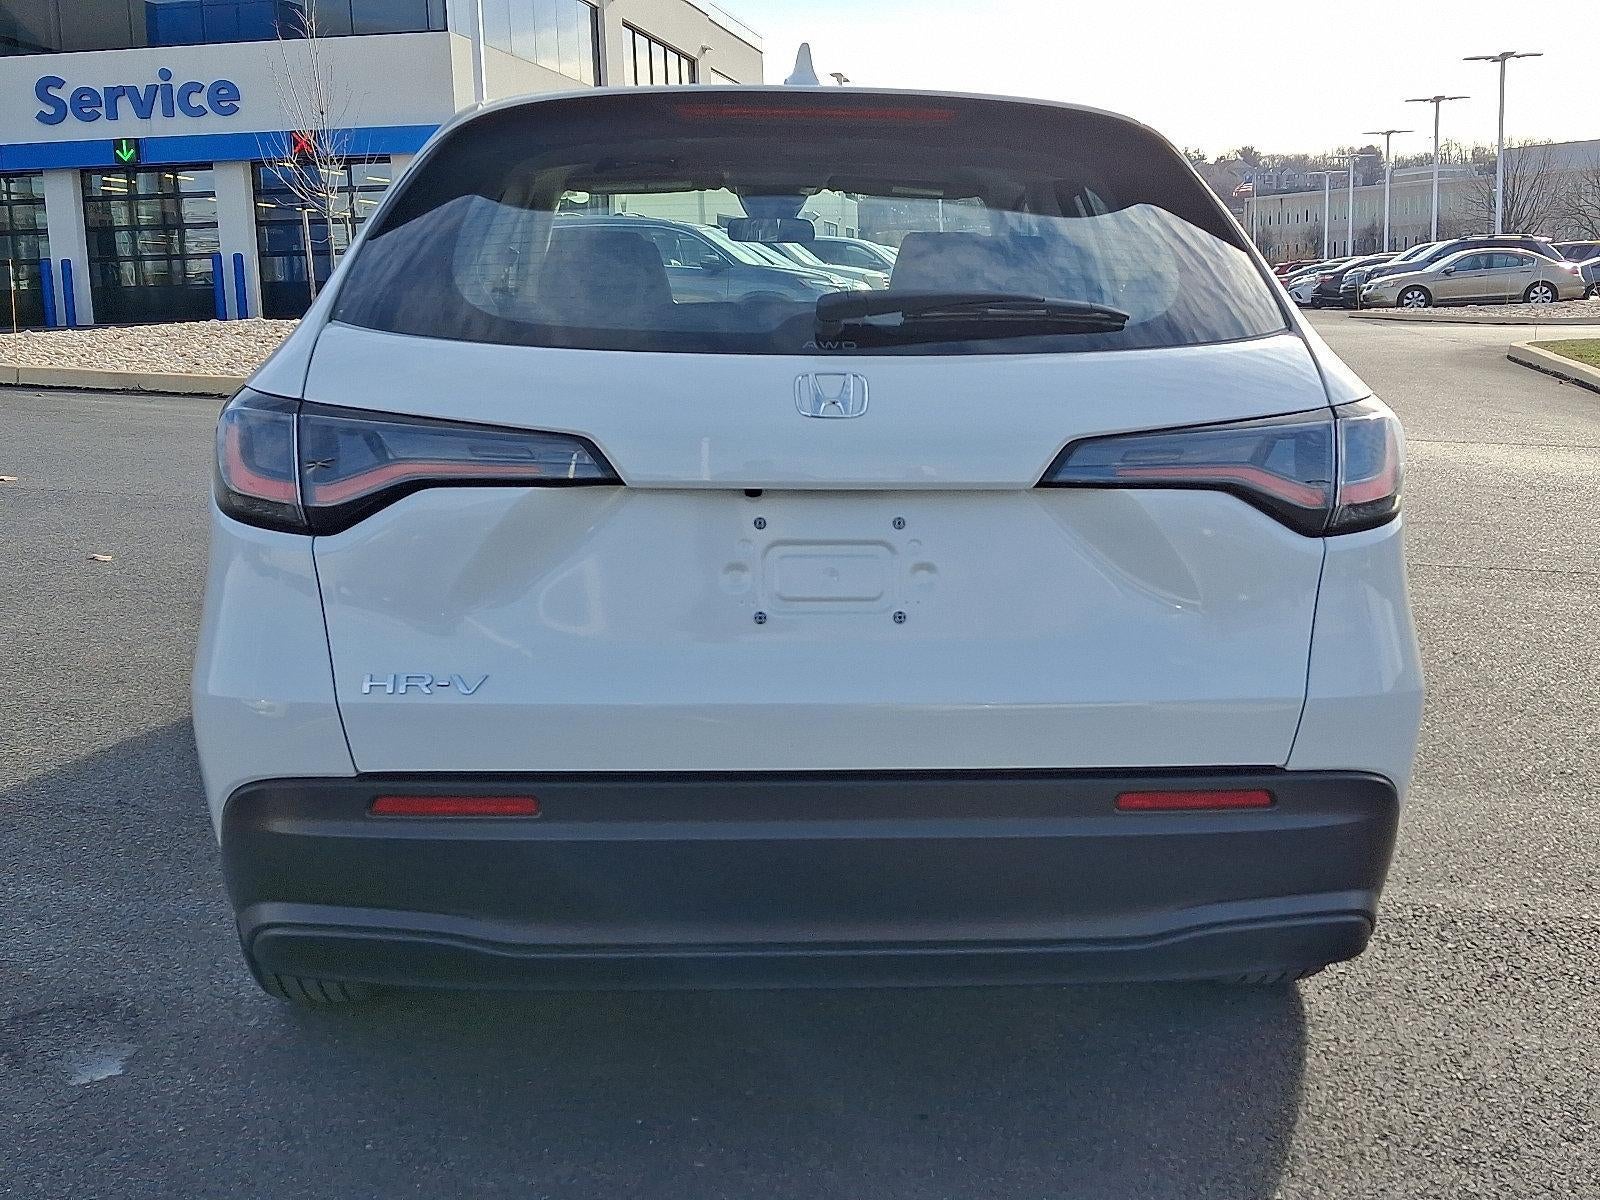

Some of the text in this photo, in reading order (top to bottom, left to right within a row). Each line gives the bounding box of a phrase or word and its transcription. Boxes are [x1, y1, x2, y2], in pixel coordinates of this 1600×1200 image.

[34, 68, 240, 125] Service
[802, 341, 857, 350] AWD
[361, 673, 490, 696] HR-V
